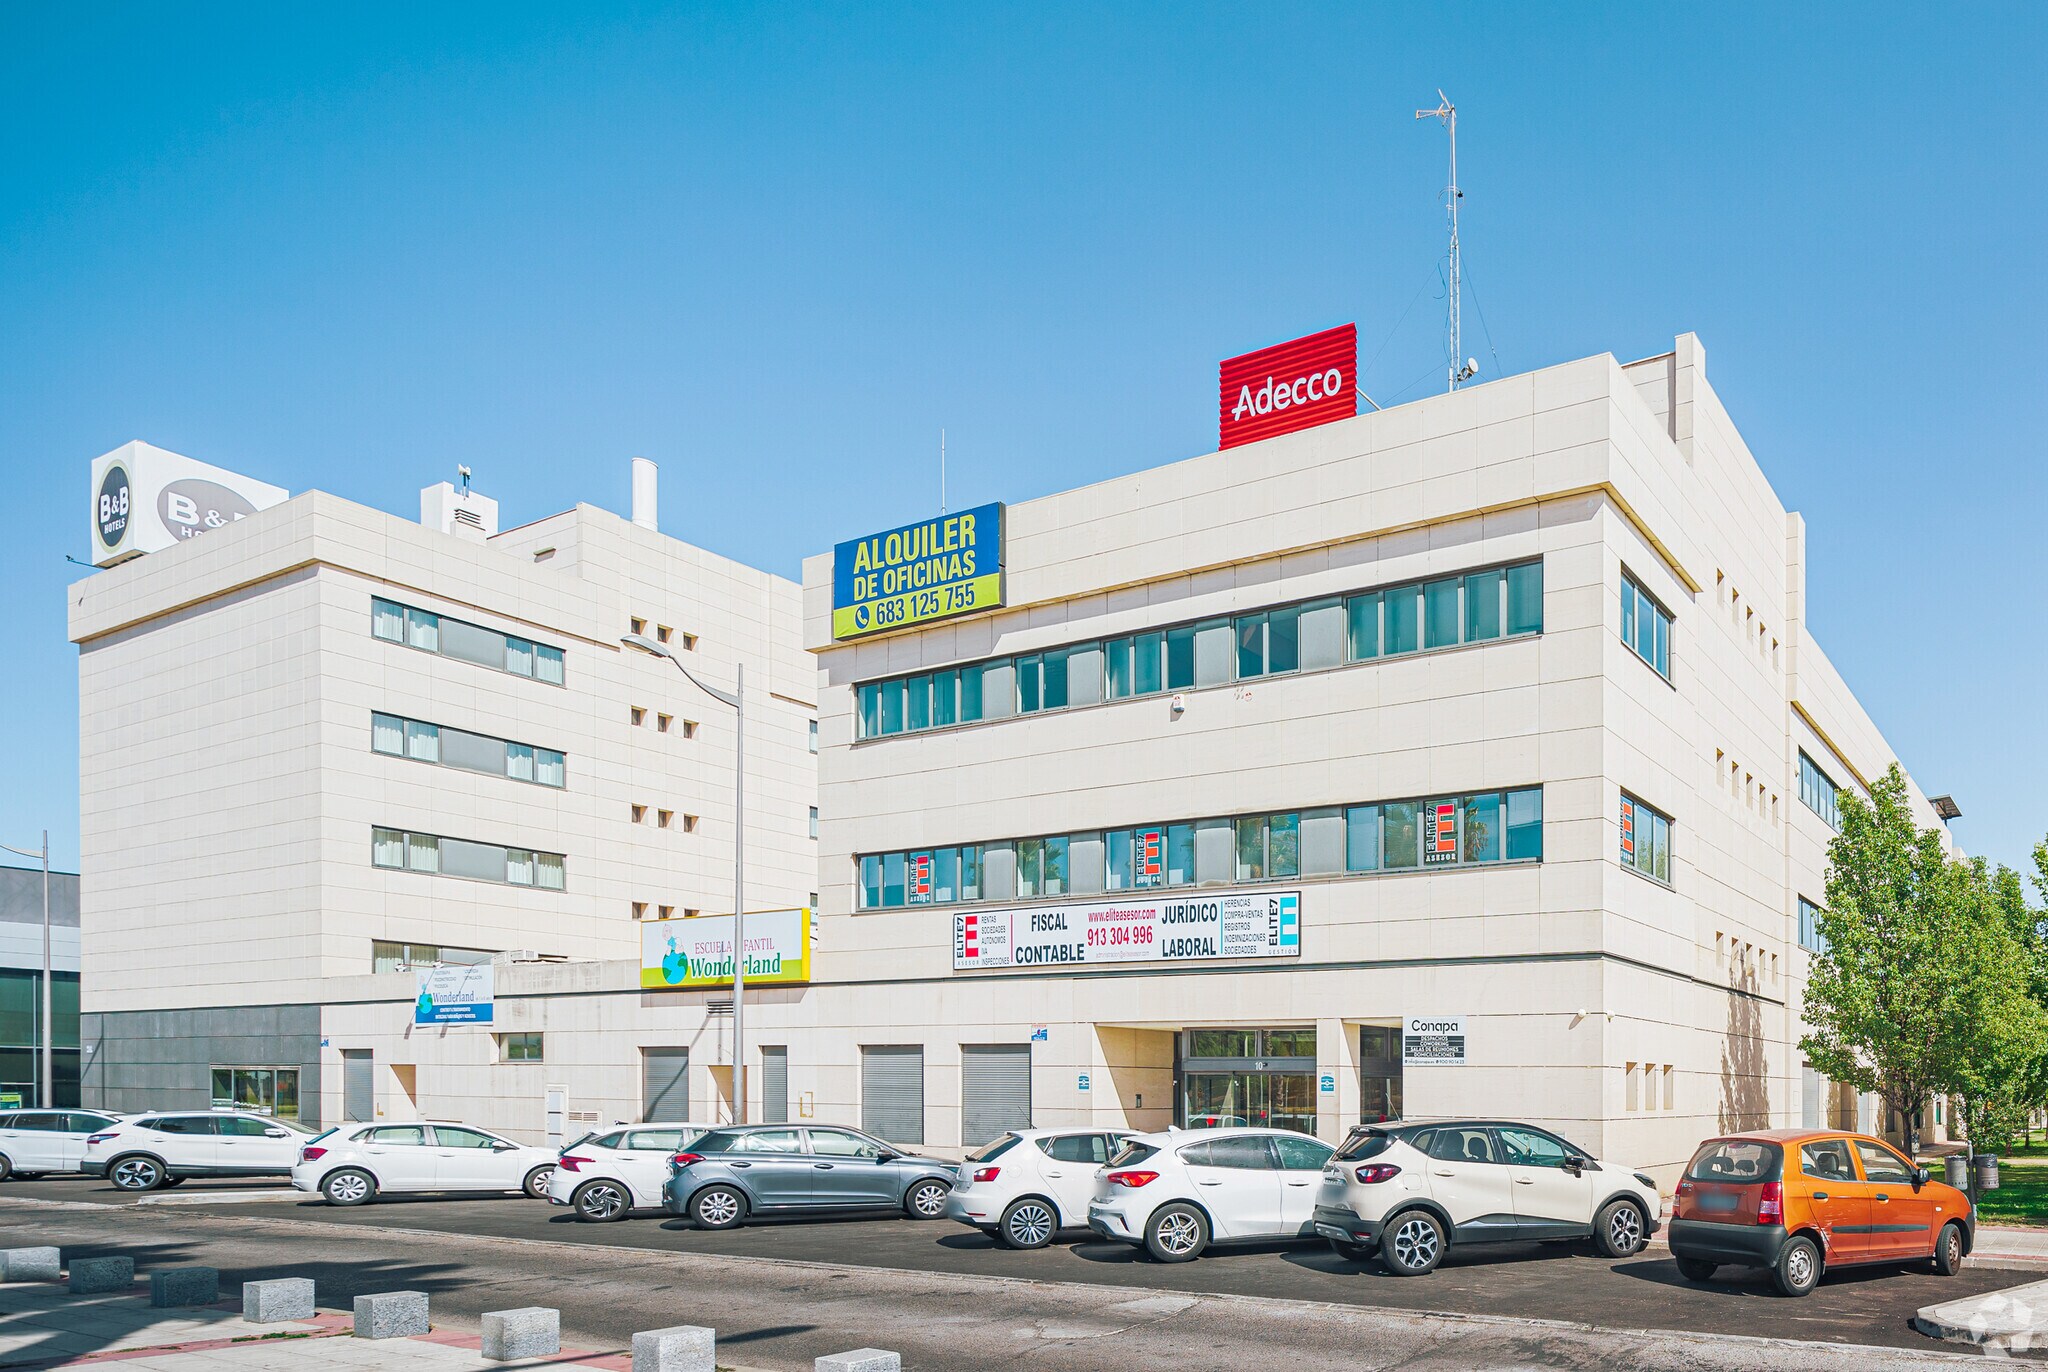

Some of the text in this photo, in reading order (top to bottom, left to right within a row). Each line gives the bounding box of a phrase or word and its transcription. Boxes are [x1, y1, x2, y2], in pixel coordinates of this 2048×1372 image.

[1231, 368, 1342, 421] Adecco
[100, 486, 129, 523] B&B
[104, 517, 126, 534] HOTELS
[853, 513, 976, 575] ALQUILER
[853, 550, 976, 601] DE OFICINAS
[876, 582, 975, 625] 683 125 755
[1426, 806, 1436, 852] ELITE7
[1137, 834, 1146, 875] ELITE7
[1161, 900, 1218, 924] JURÍDICO
[1224, 898, 1251, 907] HERENCIAS
[981, 915, 997, 924] RENTAS
[1031, 913, 1068, 932] FISCAL
[1087, 908, 1156, 923] www.eliteasesor.com
[1224, 909, 1263, 919] COMPRA-VENTAS
[1268, 898, 1278, 946] ELITE7
[1087, 925, 1153, 946] 913 304 996
[1224, 922, 1251, 931] REGISTROS
[695, 938, 775, 955] ESCUELA FANTIL
[956, 916, 964, 958] ELITE7
[1162, 937, 1217, 957] LABORAL
[981, 957, 1010, 966] INSPECCIONES
[1015, 943, 1085, 964] CONTABLE
[690, 952, 781, 978] Wondrland
[432, 991, 475, 1003] Wonderland
[1411, 1019, 1458, 1035] Conapa
[1255, 1061, 1263, 1071] 10
